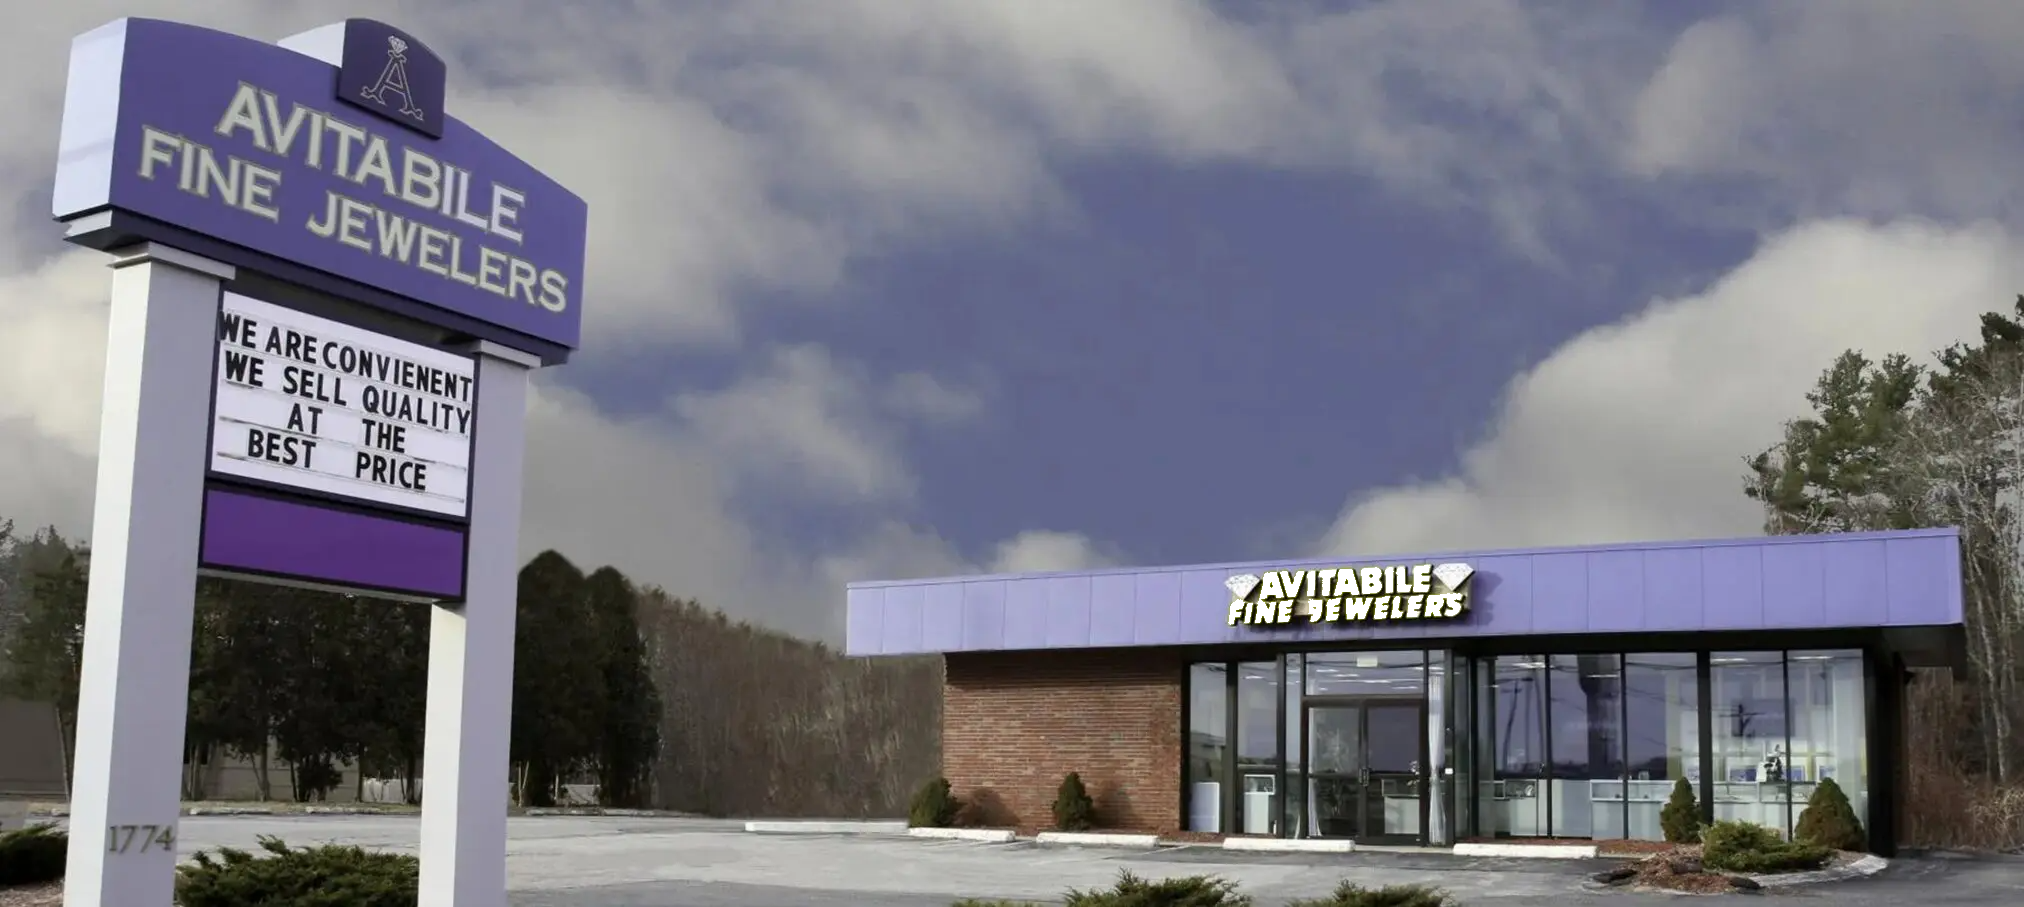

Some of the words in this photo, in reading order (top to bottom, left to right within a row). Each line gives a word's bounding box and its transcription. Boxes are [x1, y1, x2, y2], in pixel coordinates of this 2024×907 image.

[215, 81, 526, 244] AVITABILE
[138, 125, 282, 221] FINE
[306, 191, 569, 313] JEWELERS
[219, 311, 257, 349] WE
[265, 326, 317, 364] ARE
[323, 342, 472, 402] CONVIENENT
[225, 350, 264, 387] WE
[283, 366, 347, 406] SELL
[362, 385, 471, 434] QUALITY
[248, 428, 316, 468] BEST
[356, 452, 427, 491] PRICE
[287, 403, 323, 435] AT
[362, 418, 406, 454] THE
[1228, 598, 1296, 626] FINE
[1307, 593, 1465, 623] JEWELERS
[1259, 564, 1433, 600] AVITABILE
[108, 825, 176, 854] 1774
